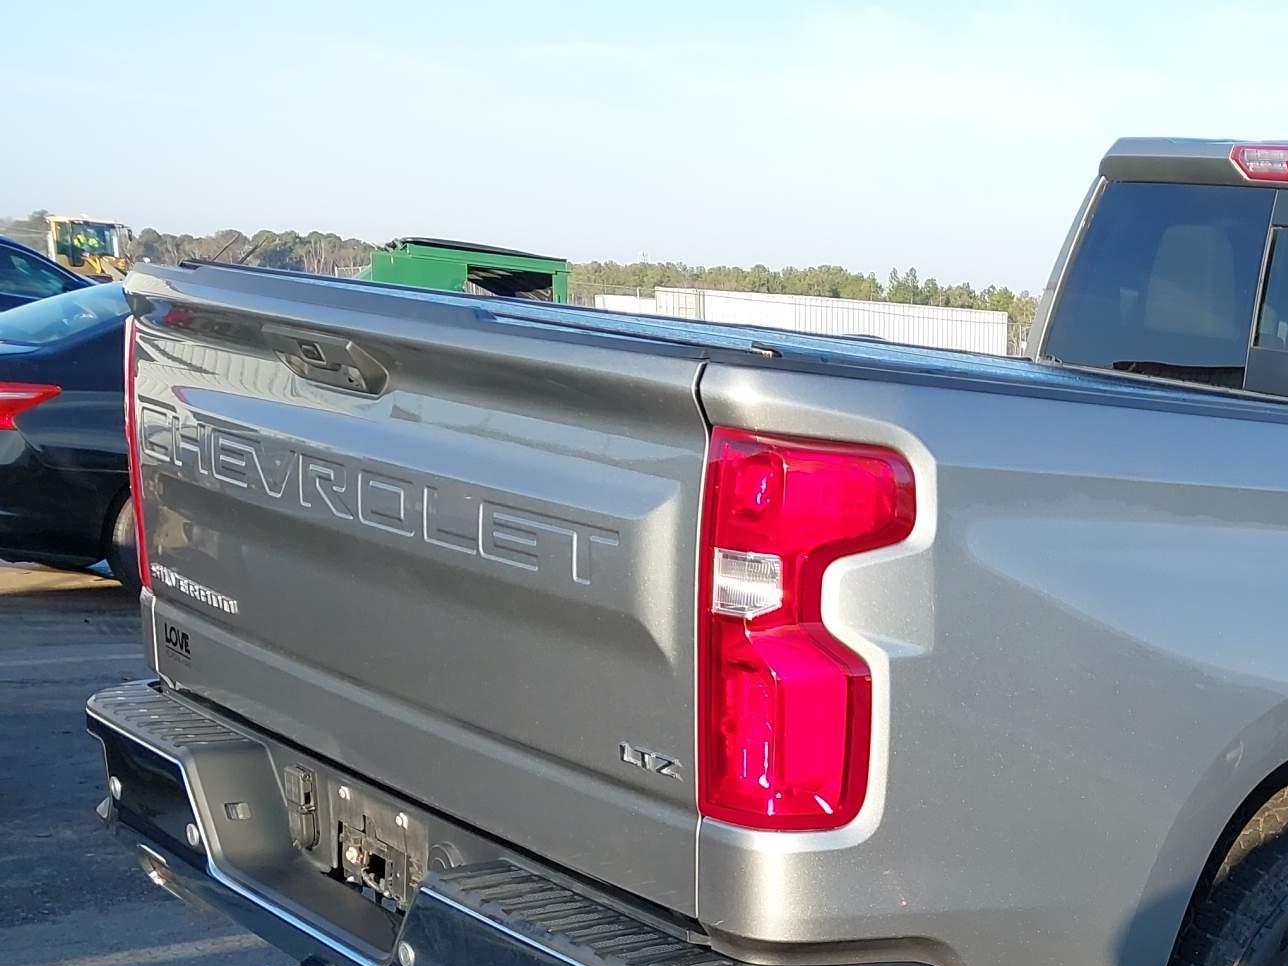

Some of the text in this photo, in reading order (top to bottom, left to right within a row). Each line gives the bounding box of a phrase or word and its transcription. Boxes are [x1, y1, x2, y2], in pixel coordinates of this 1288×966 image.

[138, 395, 621, 587] CHEVROLET
[164, 622, 191, 655] LOVE
[619, 742, 684, 782] LTZ
